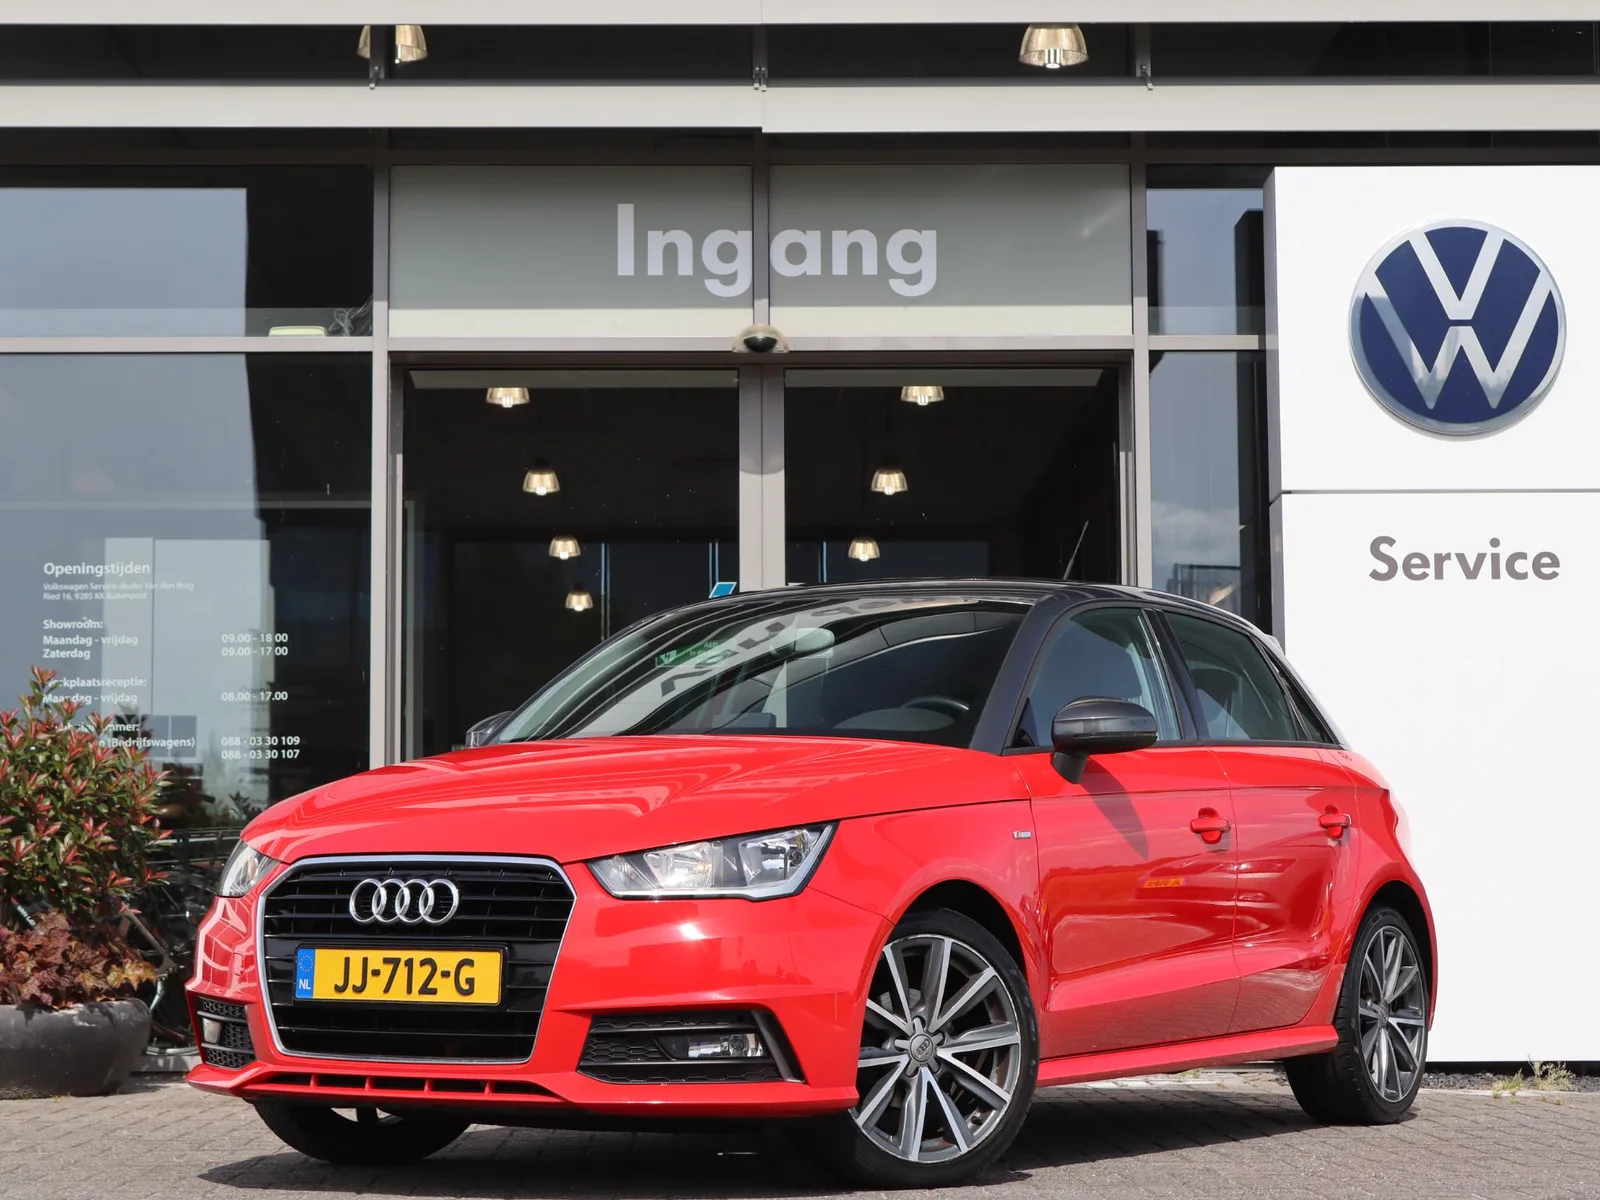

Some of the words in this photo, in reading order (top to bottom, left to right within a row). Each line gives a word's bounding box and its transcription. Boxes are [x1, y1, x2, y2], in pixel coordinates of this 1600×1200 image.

[617, 203, 937, 298] Ingang
[1368, 535, 1561, 582] Service
[43, 562, 151, 578] Openingstijden
[42, 582, 89, 592] Volkswagen
[160, 581, 175, 590] den
[176, 581, 195, 592] Brug
[43, 592, 61, 600] Ried
[74, 592, 93, 600] 9285
[43, 619, 104, 630] Showroom:
[43, 635, 93, 647] Maandag
[101, 634, 139, 647] vrijdag
[221, 633, 251, 643] 09.00
[43, 648, 91, 661] Zaterdag
[221, 646, 251, 656] 09.00
[46, 677, 148, 690] kplaatsreceptie:
[101, 692, 138, 705] vrijdag
[221, 691, 251, 701] 08.00
[259, 691, 289, 701] 17.00
[221, 736, 241, 746] 088
[249, 736, 262, 746] 03
[265, 736, 279, 746] 30
[281, 735, 300, 746] 109
[221, 750, 241, 760] 088
[249, 749, 262, 760] 03
[265, 749, 279, 760] 30
[281, 749, 300, 759] 107
[333, 956, 476, 997] JJ-712-G
[298, 977, 312, 991] NL
